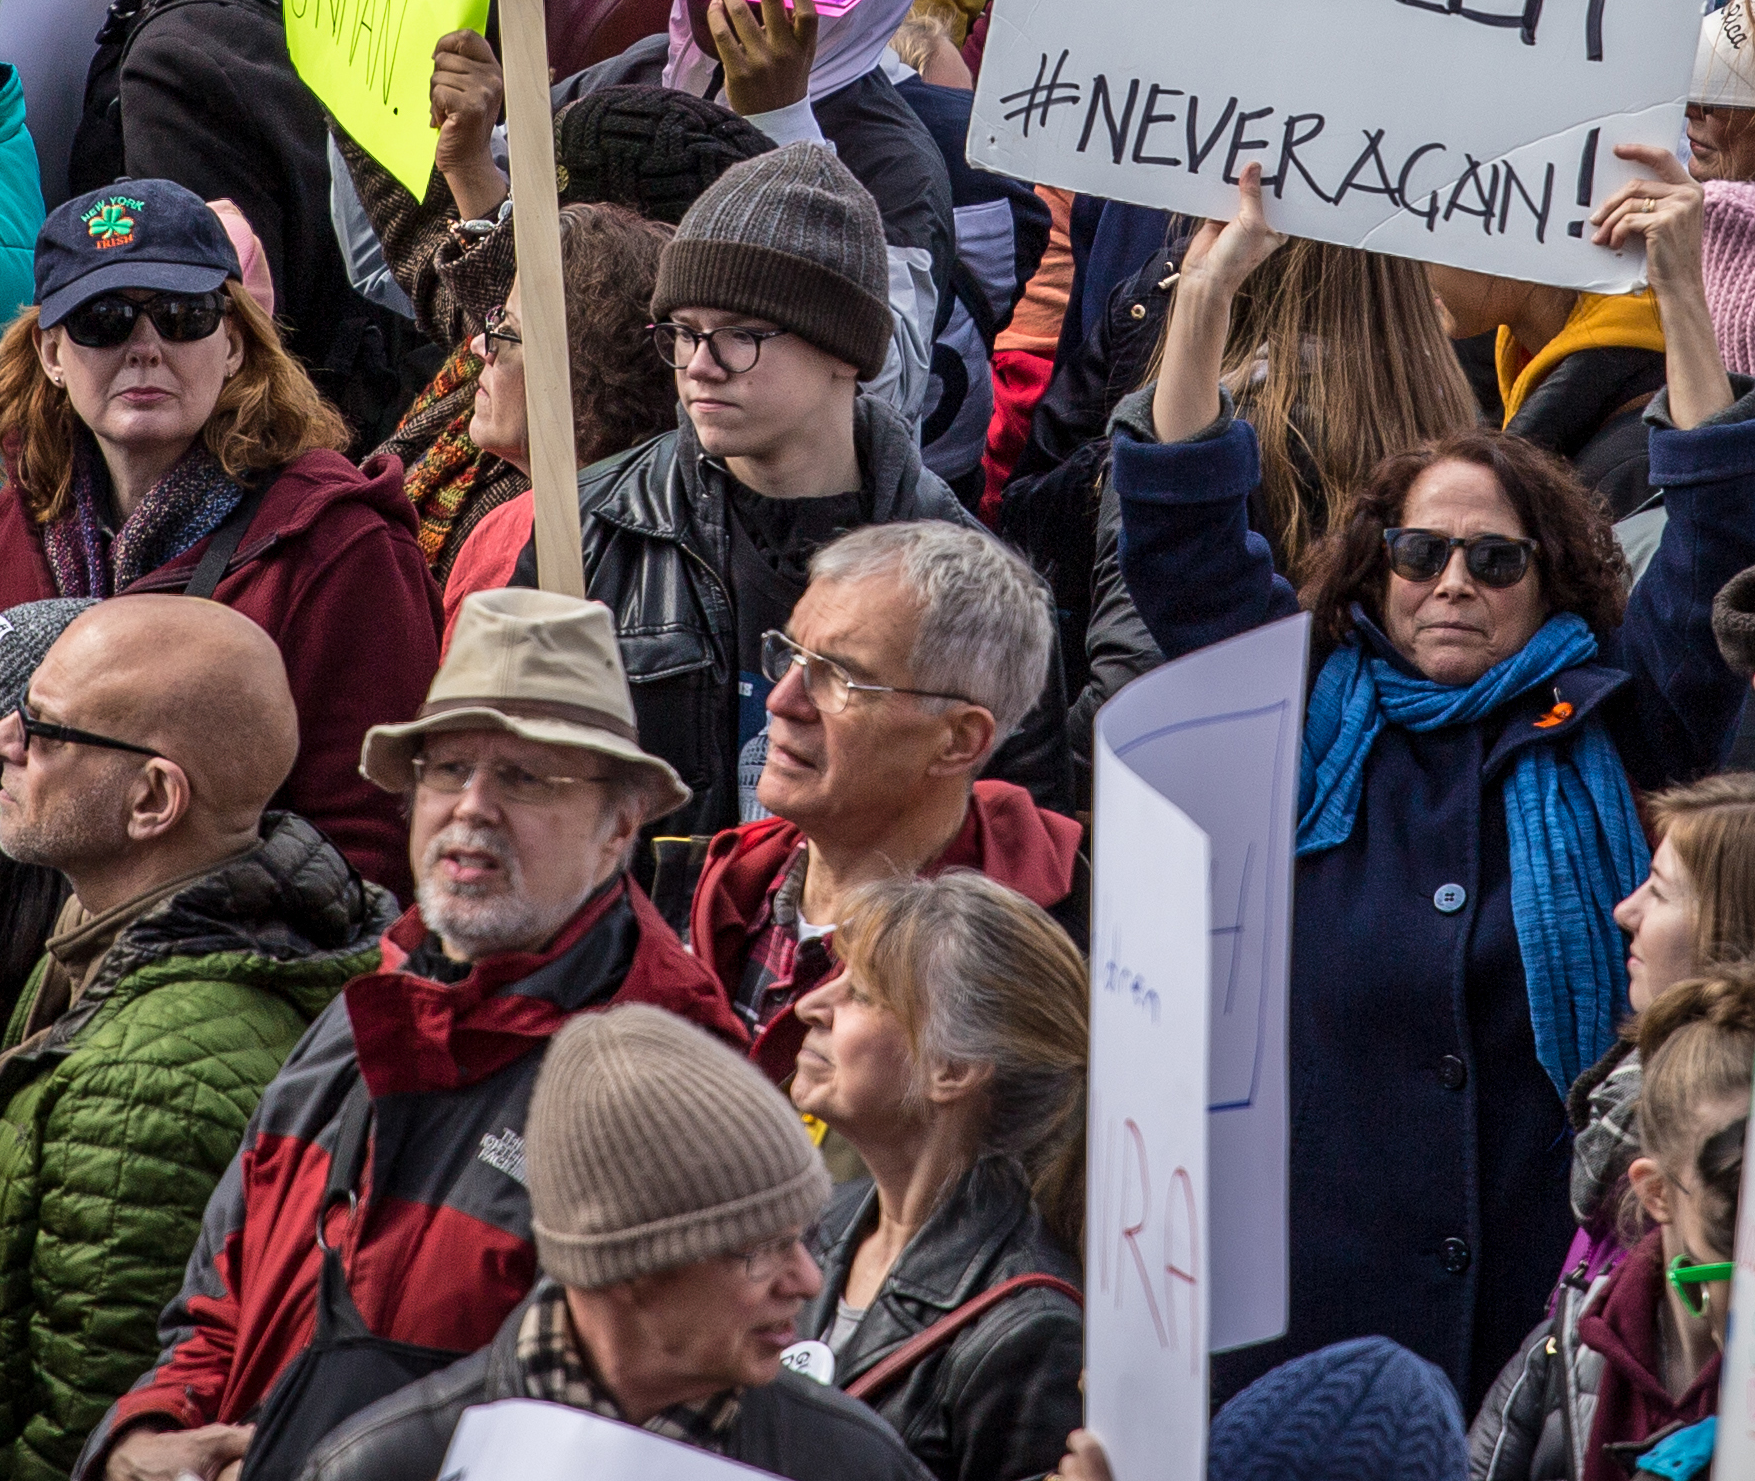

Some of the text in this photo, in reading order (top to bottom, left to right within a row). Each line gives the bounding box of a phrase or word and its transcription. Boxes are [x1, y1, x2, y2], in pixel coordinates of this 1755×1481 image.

[80, 196, 145, 222] NEW YORK
[95, 234, 134, 250] IRISH
